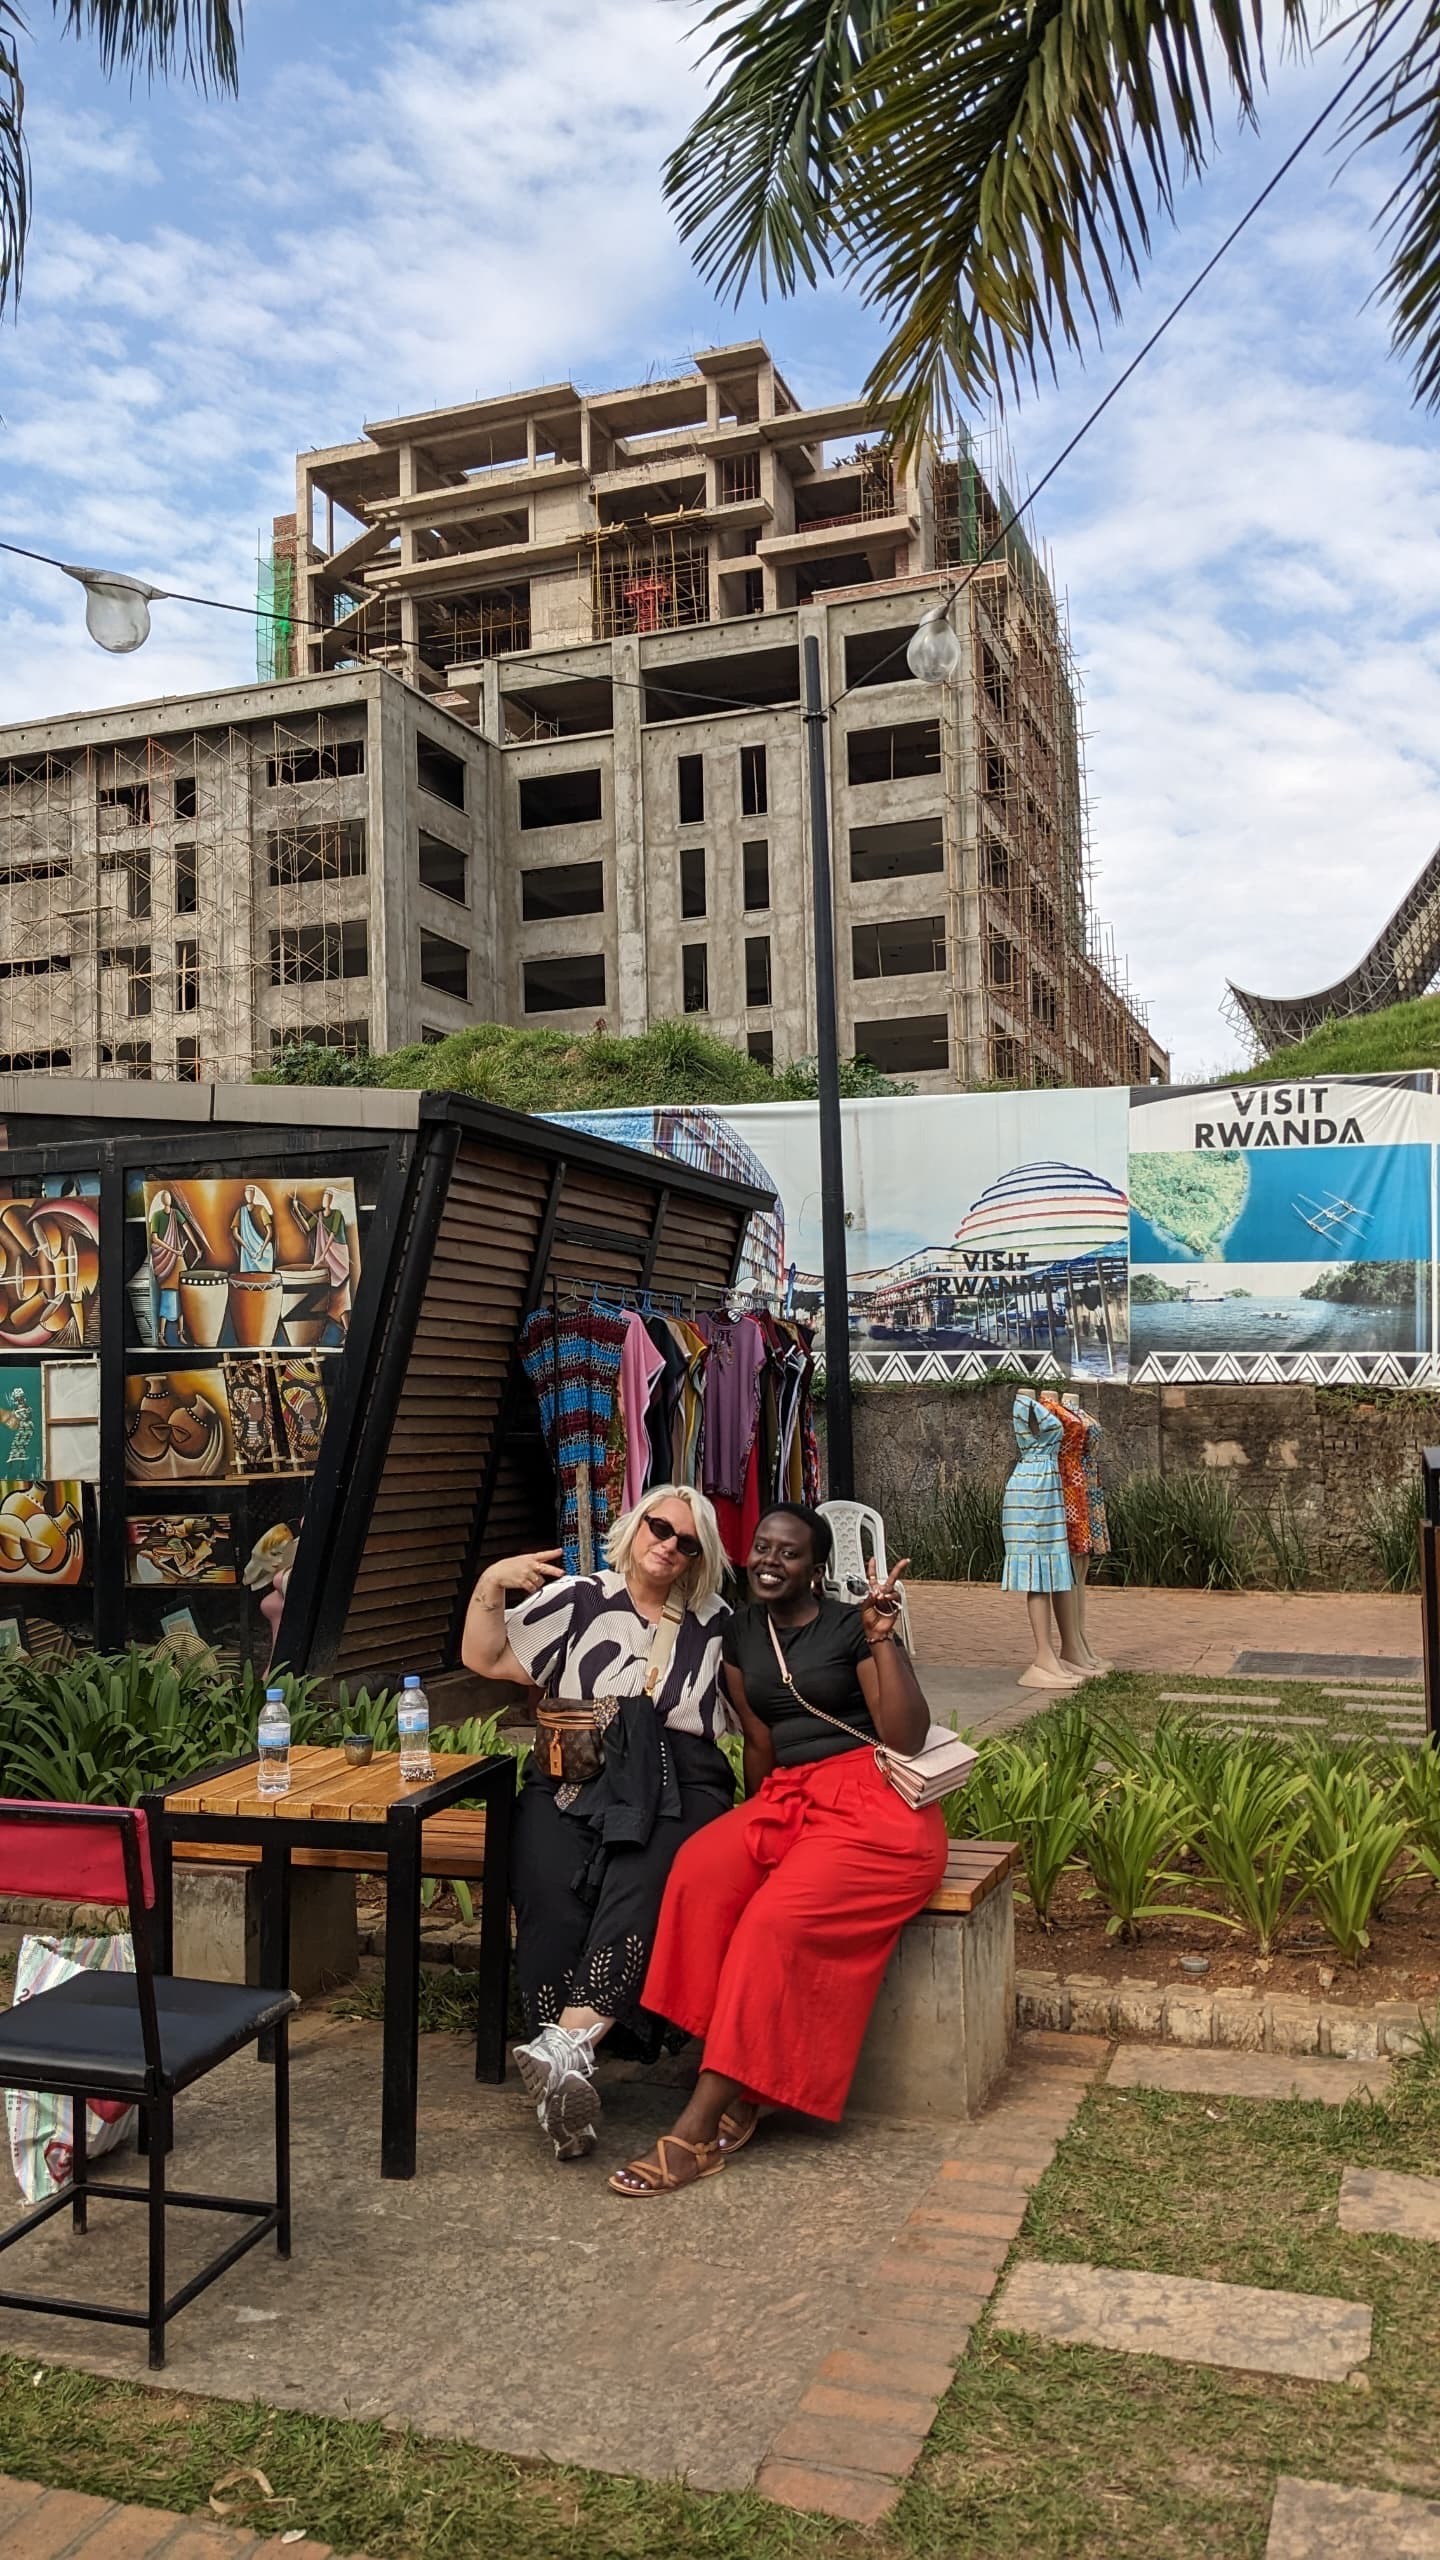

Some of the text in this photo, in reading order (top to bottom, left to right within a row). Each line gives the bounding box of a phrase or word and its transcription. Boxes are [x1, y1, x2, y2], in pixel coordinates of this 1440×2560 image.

[1231, 1087, 1329, 1117] VISIT
[1195, 1117, 1365, 1149] RWANDA
[962, 1252, 1030, 1271] VISIT
